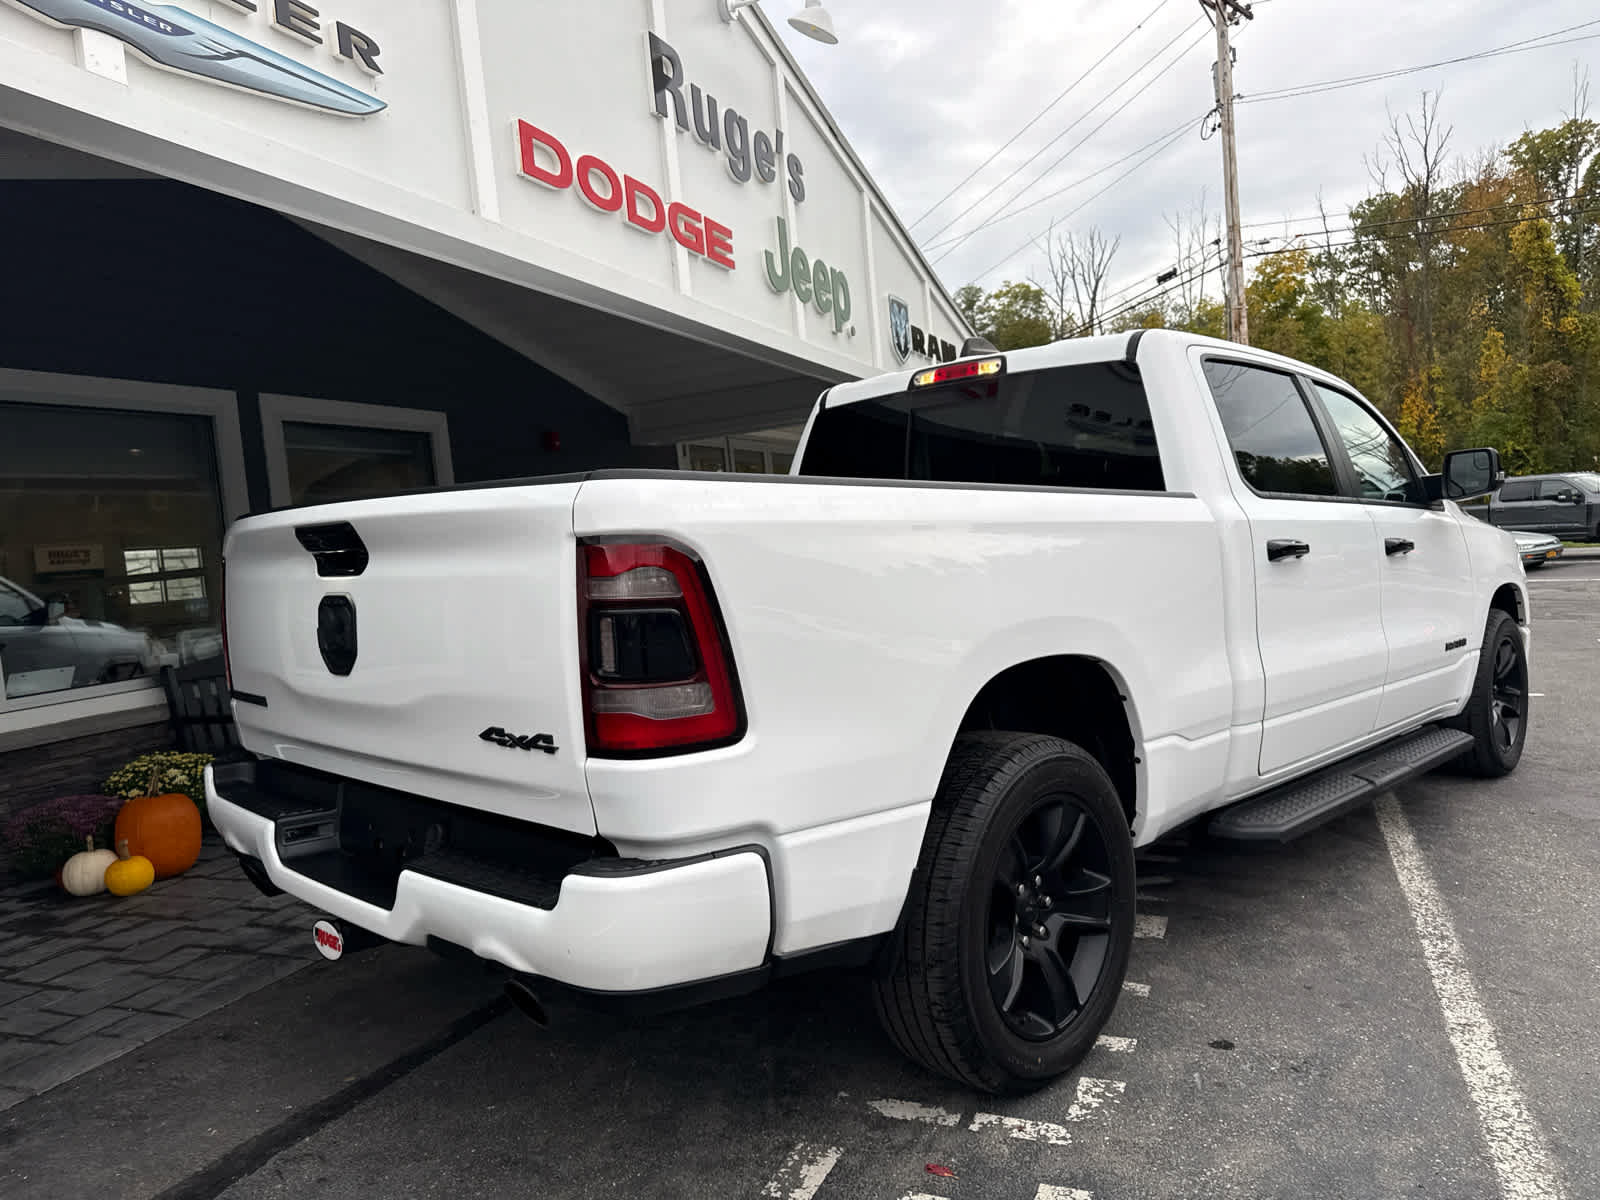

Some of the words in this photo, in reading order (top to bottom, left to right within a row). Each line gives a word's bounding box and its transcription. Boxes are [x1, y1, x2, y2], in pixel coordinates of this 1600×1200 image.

[648, 31, 805, 202] Ruge's
[518, 118, 736, 270] DODGE
[911, 325, 957, 363] RAM
